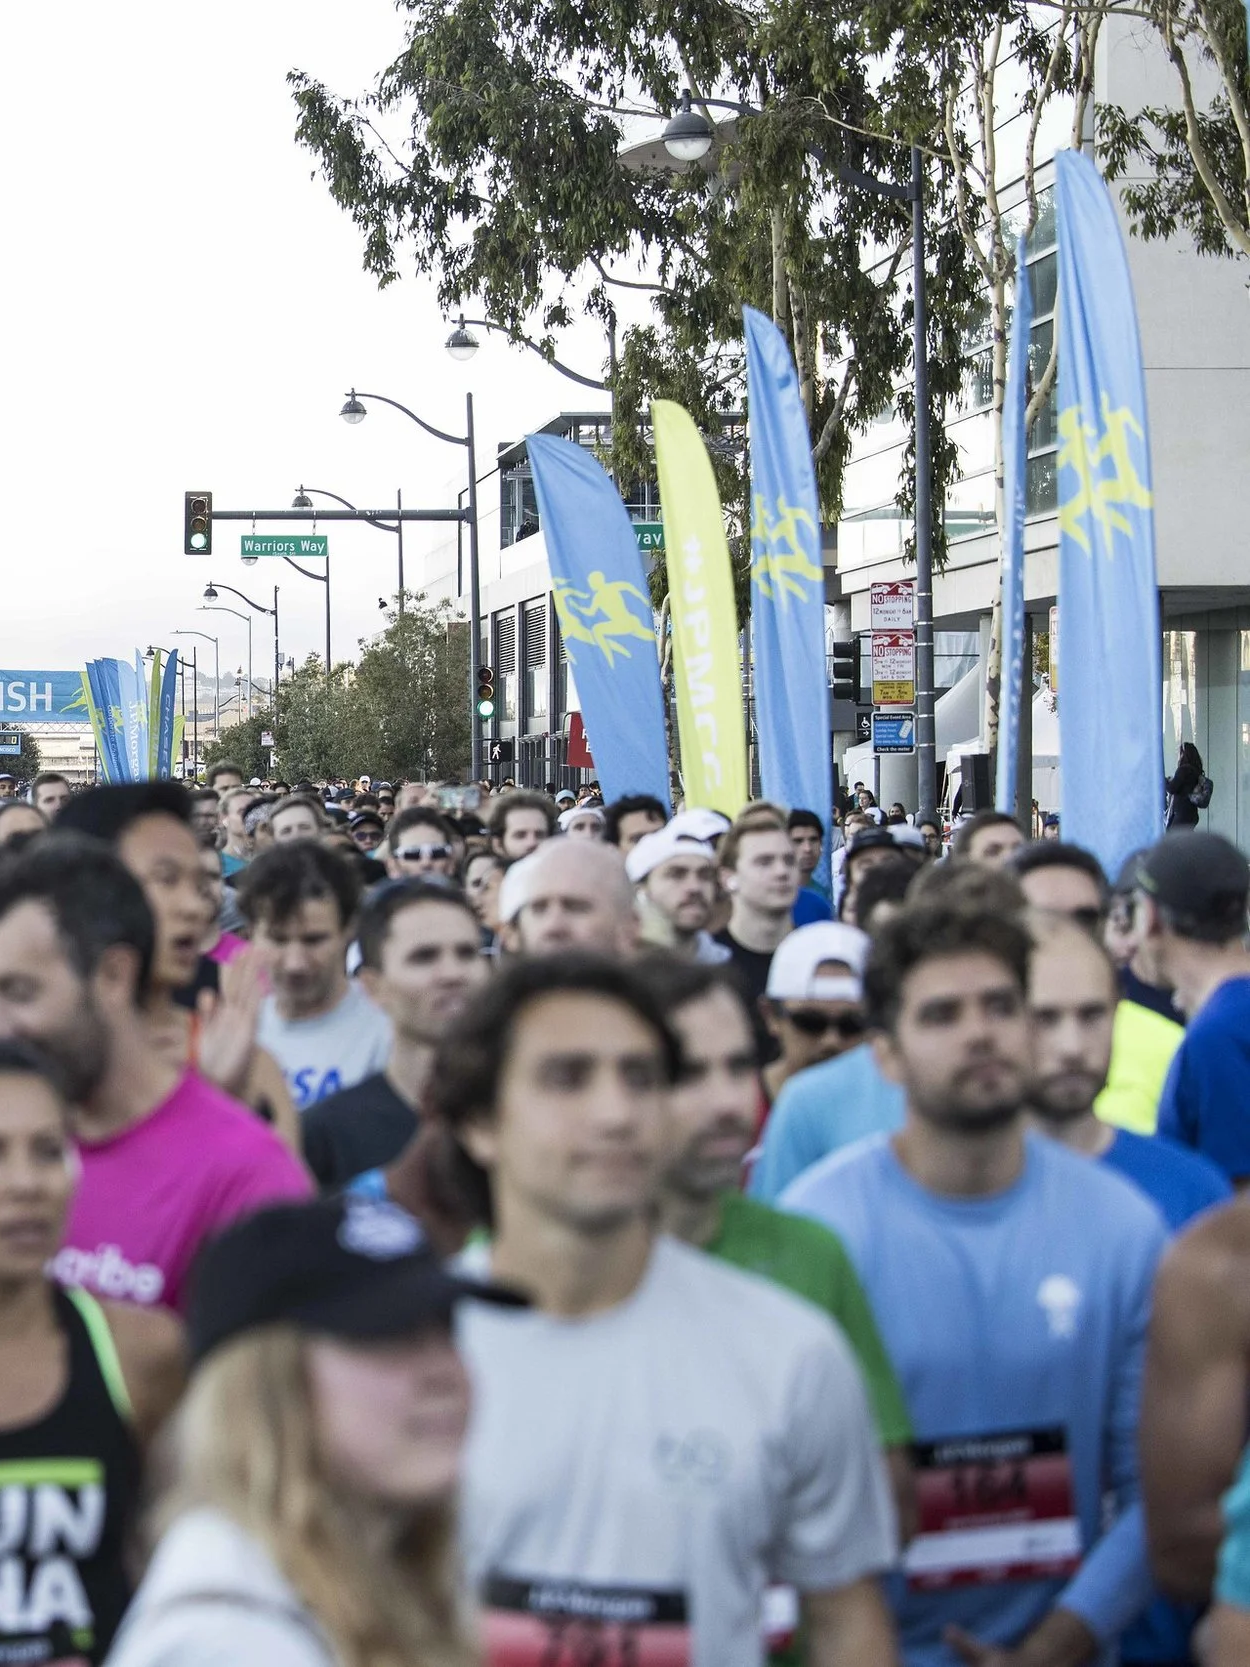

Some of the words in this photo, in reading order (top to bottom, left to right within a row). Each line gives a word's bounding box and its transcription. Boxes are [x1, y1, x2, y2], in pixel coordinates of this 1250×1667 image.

[244, 540, 296, 552] Warriors
[300, 540, 325, 554] Way
[872, 594, 884, 604] NO
[885, 596, 912, 604] STOPPING
[873, 645, 885, 657] NO
[885, 647, 912, 656] STOPPING
